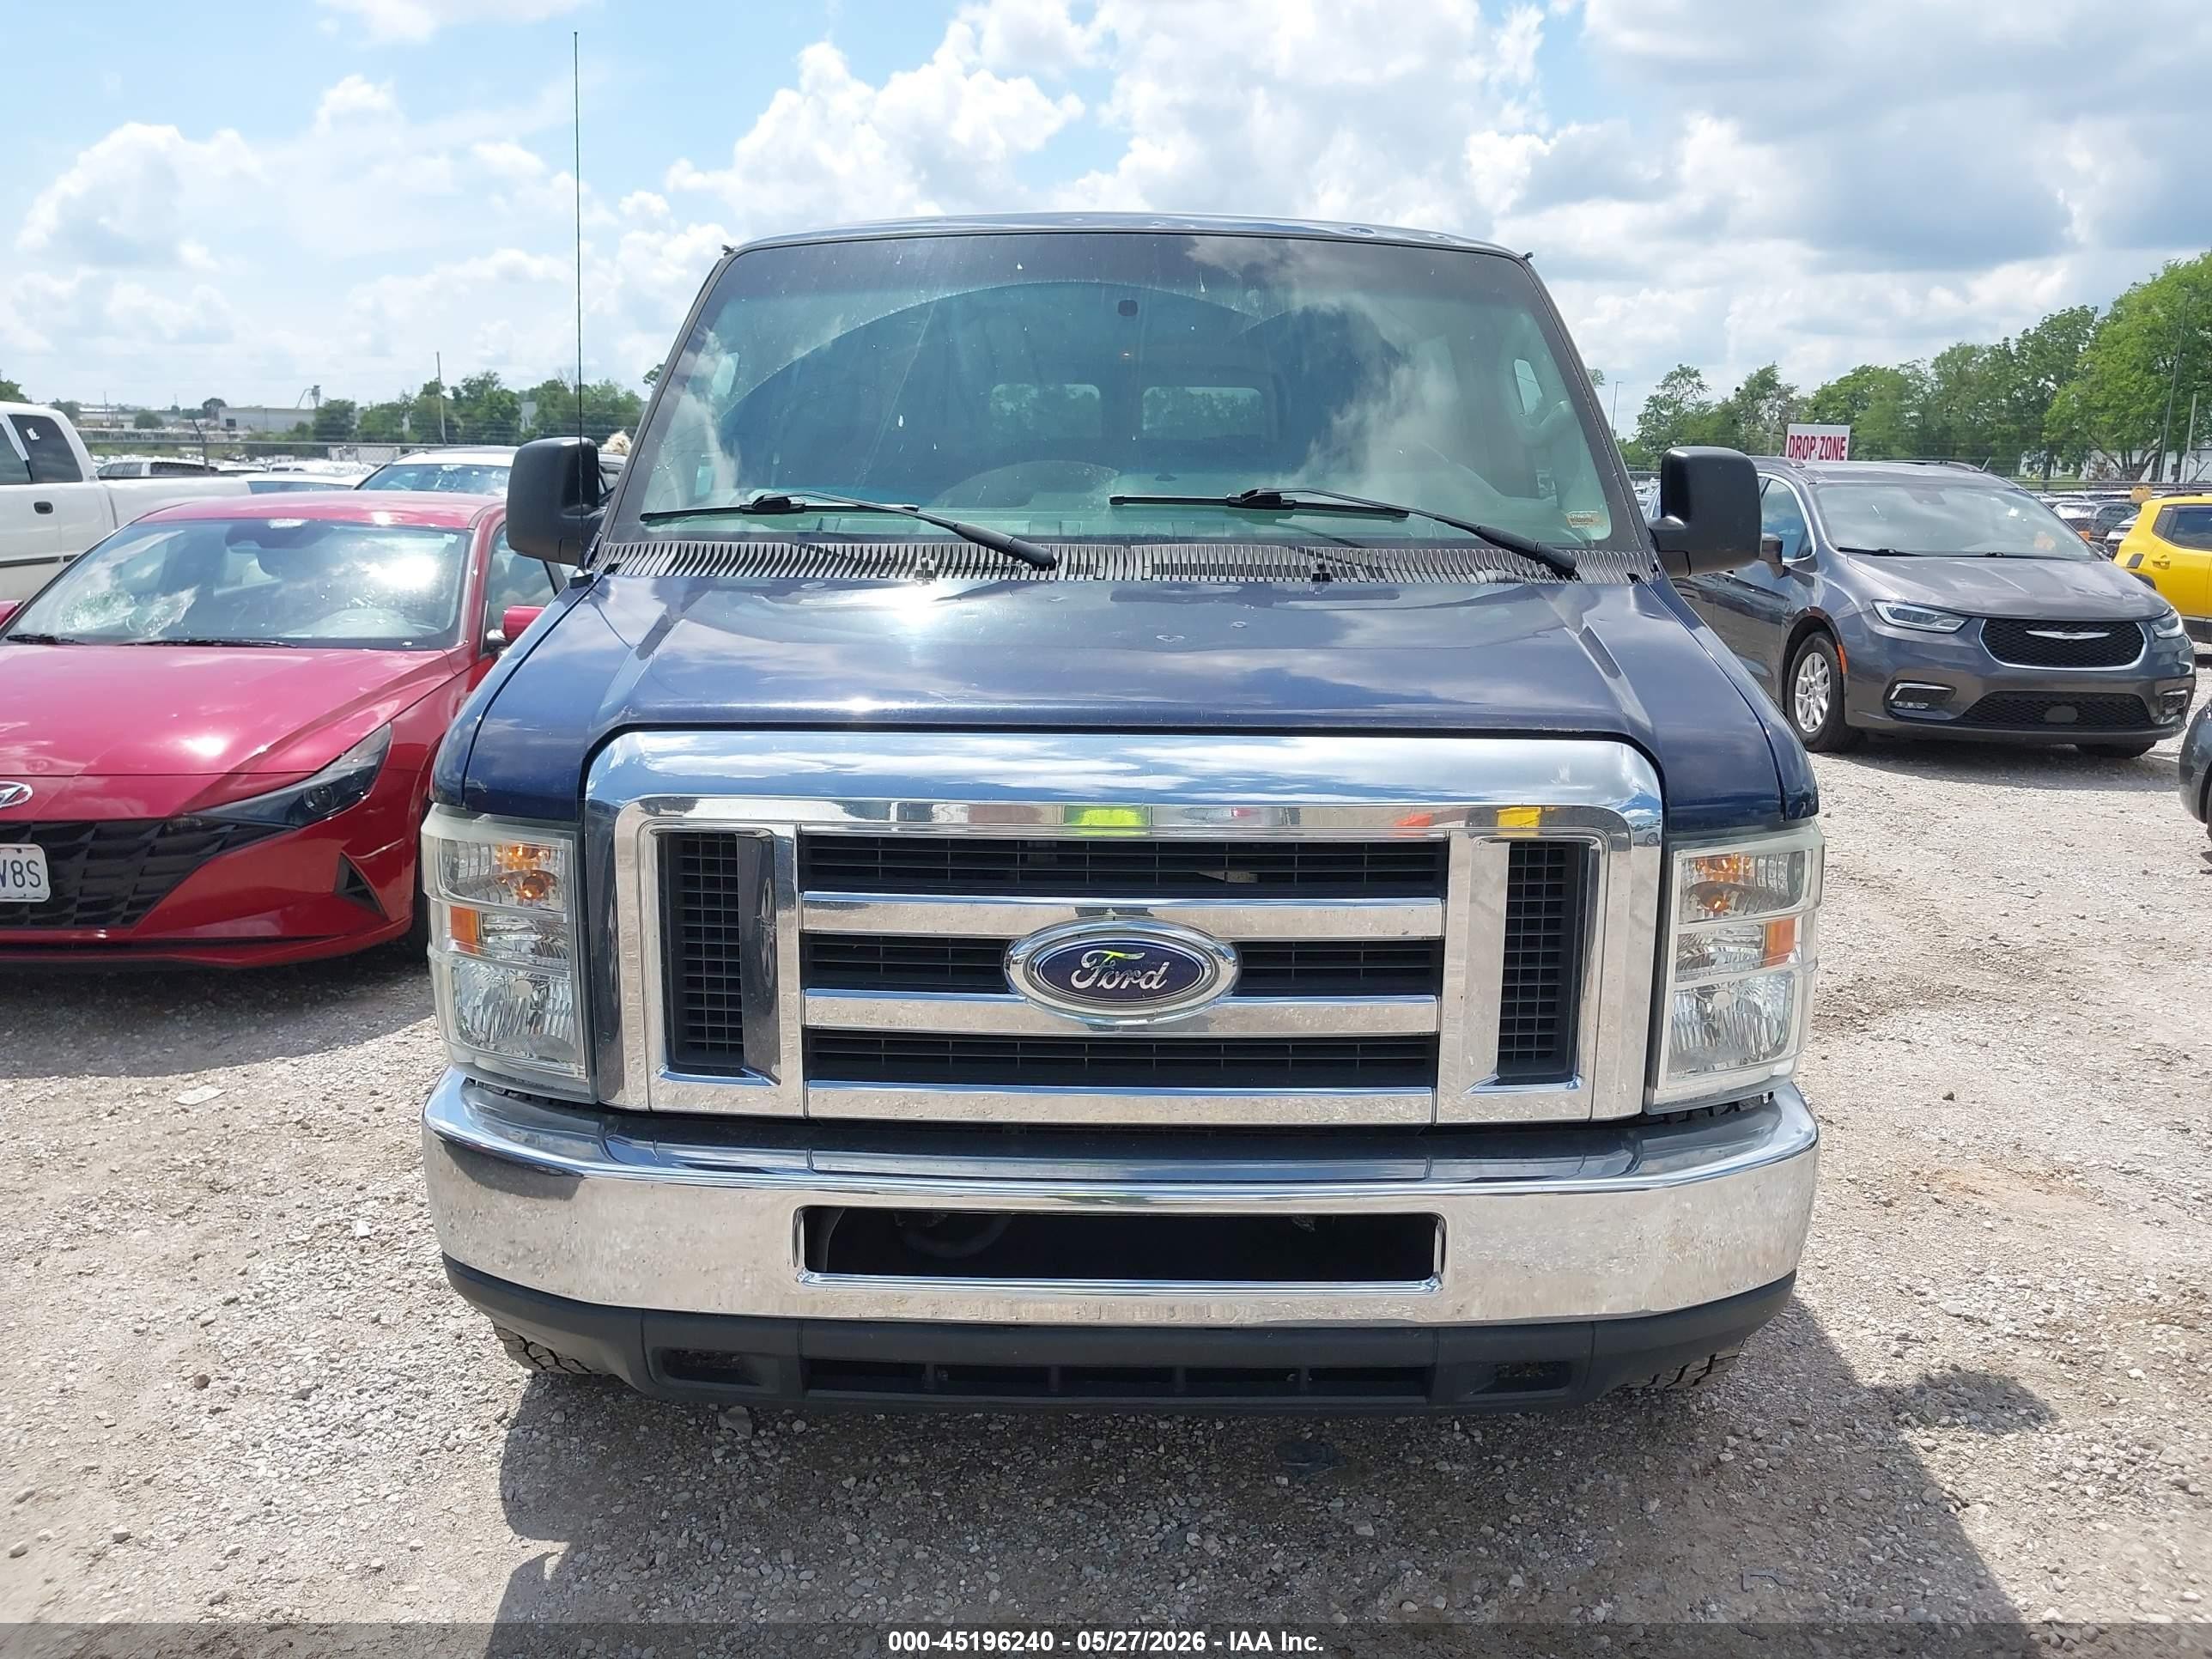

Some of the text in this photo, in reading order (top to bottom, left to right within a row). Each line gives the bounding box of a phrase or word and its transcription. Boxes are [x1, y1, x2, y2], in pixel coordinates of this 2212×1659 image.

[1788, 434, 1846, 461] DROP ZONE
[1070, 949, 1169, 990] Ford
